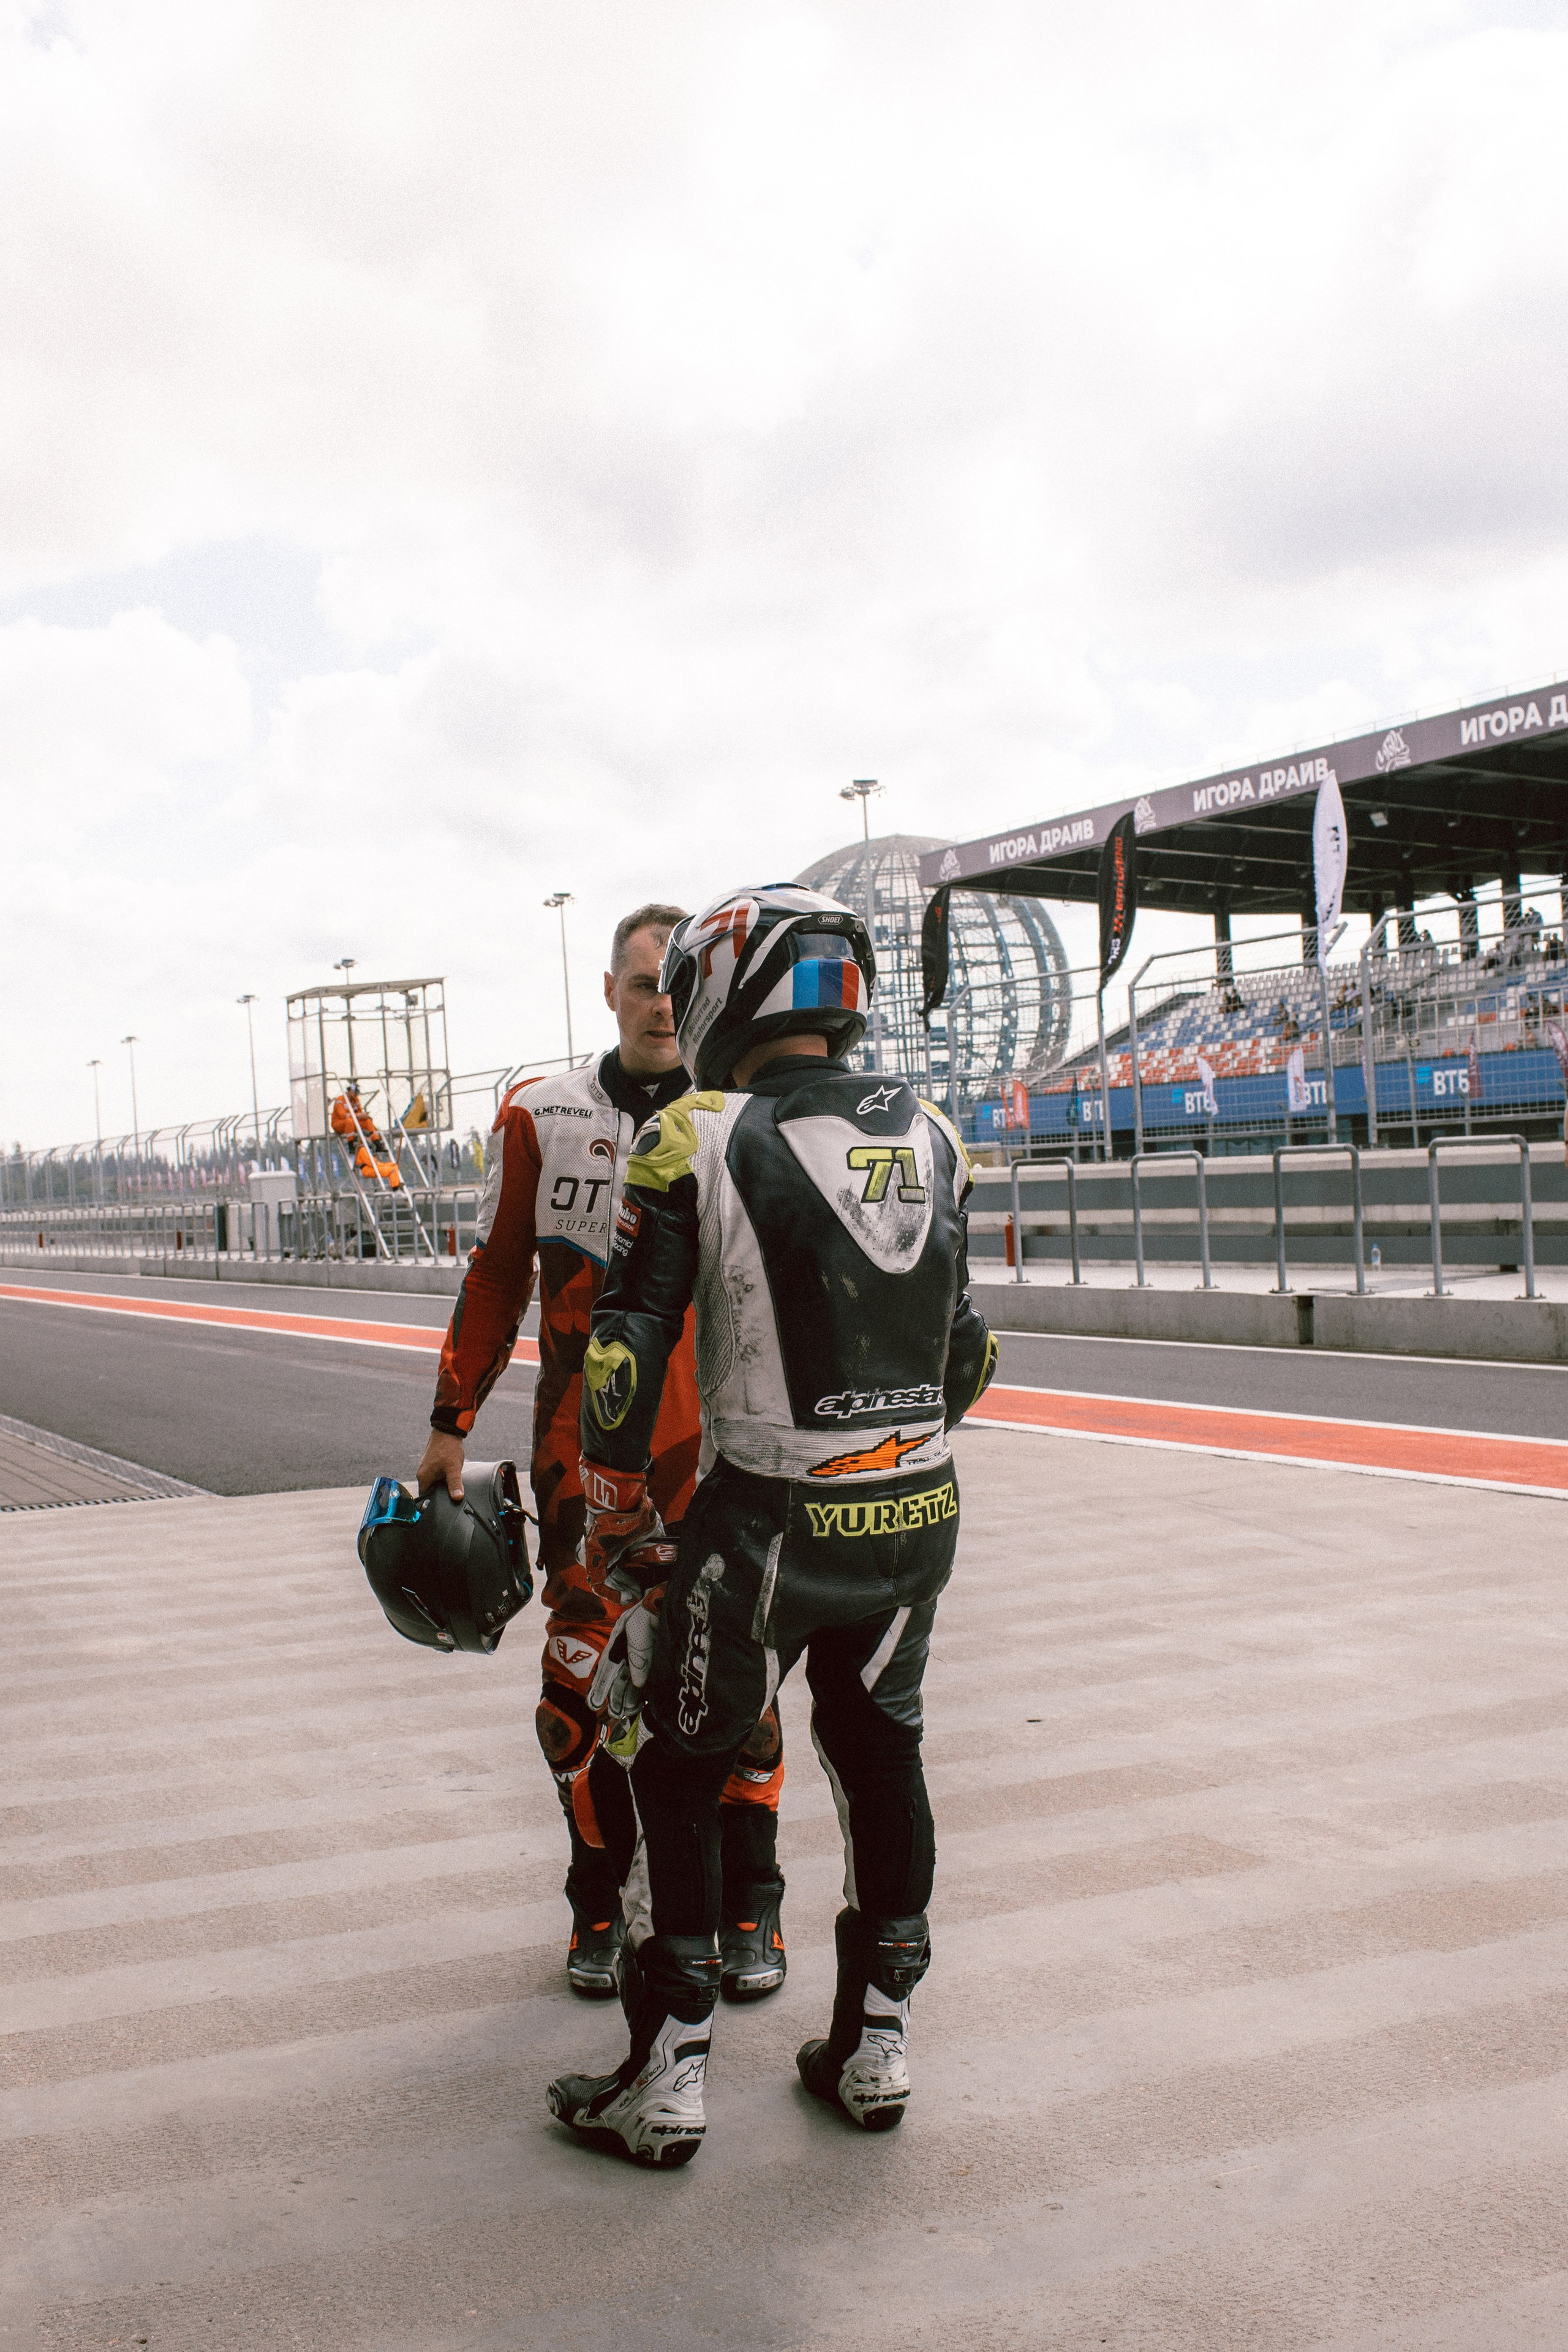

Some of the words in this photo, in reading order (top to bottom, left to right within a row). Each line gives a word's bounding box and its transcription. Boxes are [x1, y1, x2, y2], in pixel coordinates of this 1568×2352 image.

[1461, 701, 1543, 745] ИГОРА
[1193, 777, 1256, 813] ИГОРА
[989, 834, 1038, 864] ИГОРА
[821, 915, 841, 924] SHOEI
[687, 996, 710, 1037] Motorrad
[692, 997, 723, 1044] Motorsport
[590, 1082, 604, 1100] OTTO
[1433, 1068, 1471, 1096] ВТБ
[533, 1105, 593, 1118] G.METREVELI
[846, 1146, 926, 1204] 71
[556, 1219, 607, 1234] SUPER
[804, 1481, 958, 1537] YURETZ
